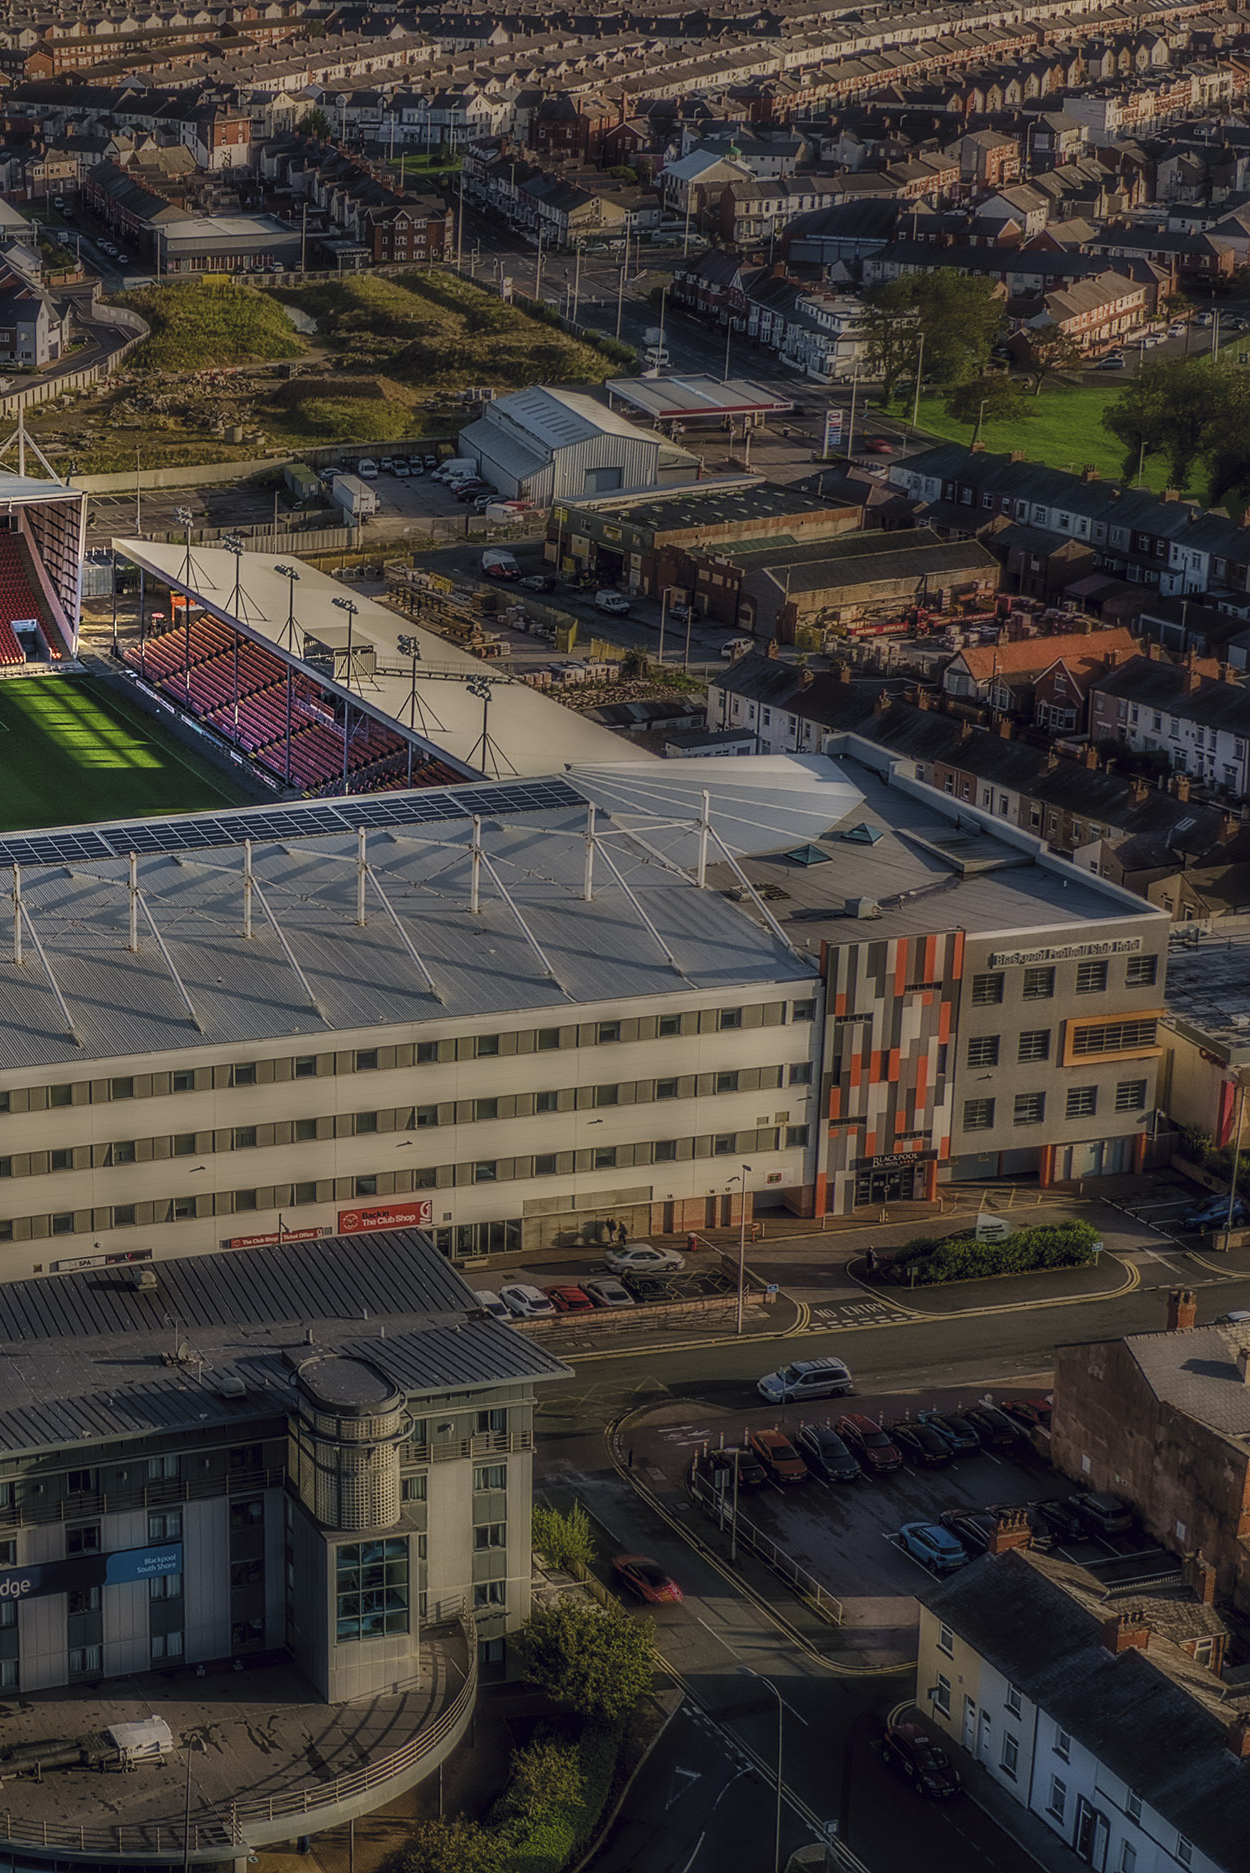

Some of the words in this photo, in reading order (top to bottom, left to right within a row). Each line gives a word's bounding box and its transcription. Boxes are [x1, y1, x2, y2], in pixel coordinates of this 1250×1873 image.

[872, 1152, 918, 1168] BLACKPOOL
[377, 1216, 395, 1225] Club
[395, 1214, 416, 1223] Shop
[814, 1309, 837, 1319] NO
[840, 1302, 887, 1316] ENTRY
[144, 1554, 176, 1565] Blackpool
[137, 1564, 156, 1573] South
[157, 1562, 176, 1570] Shore
